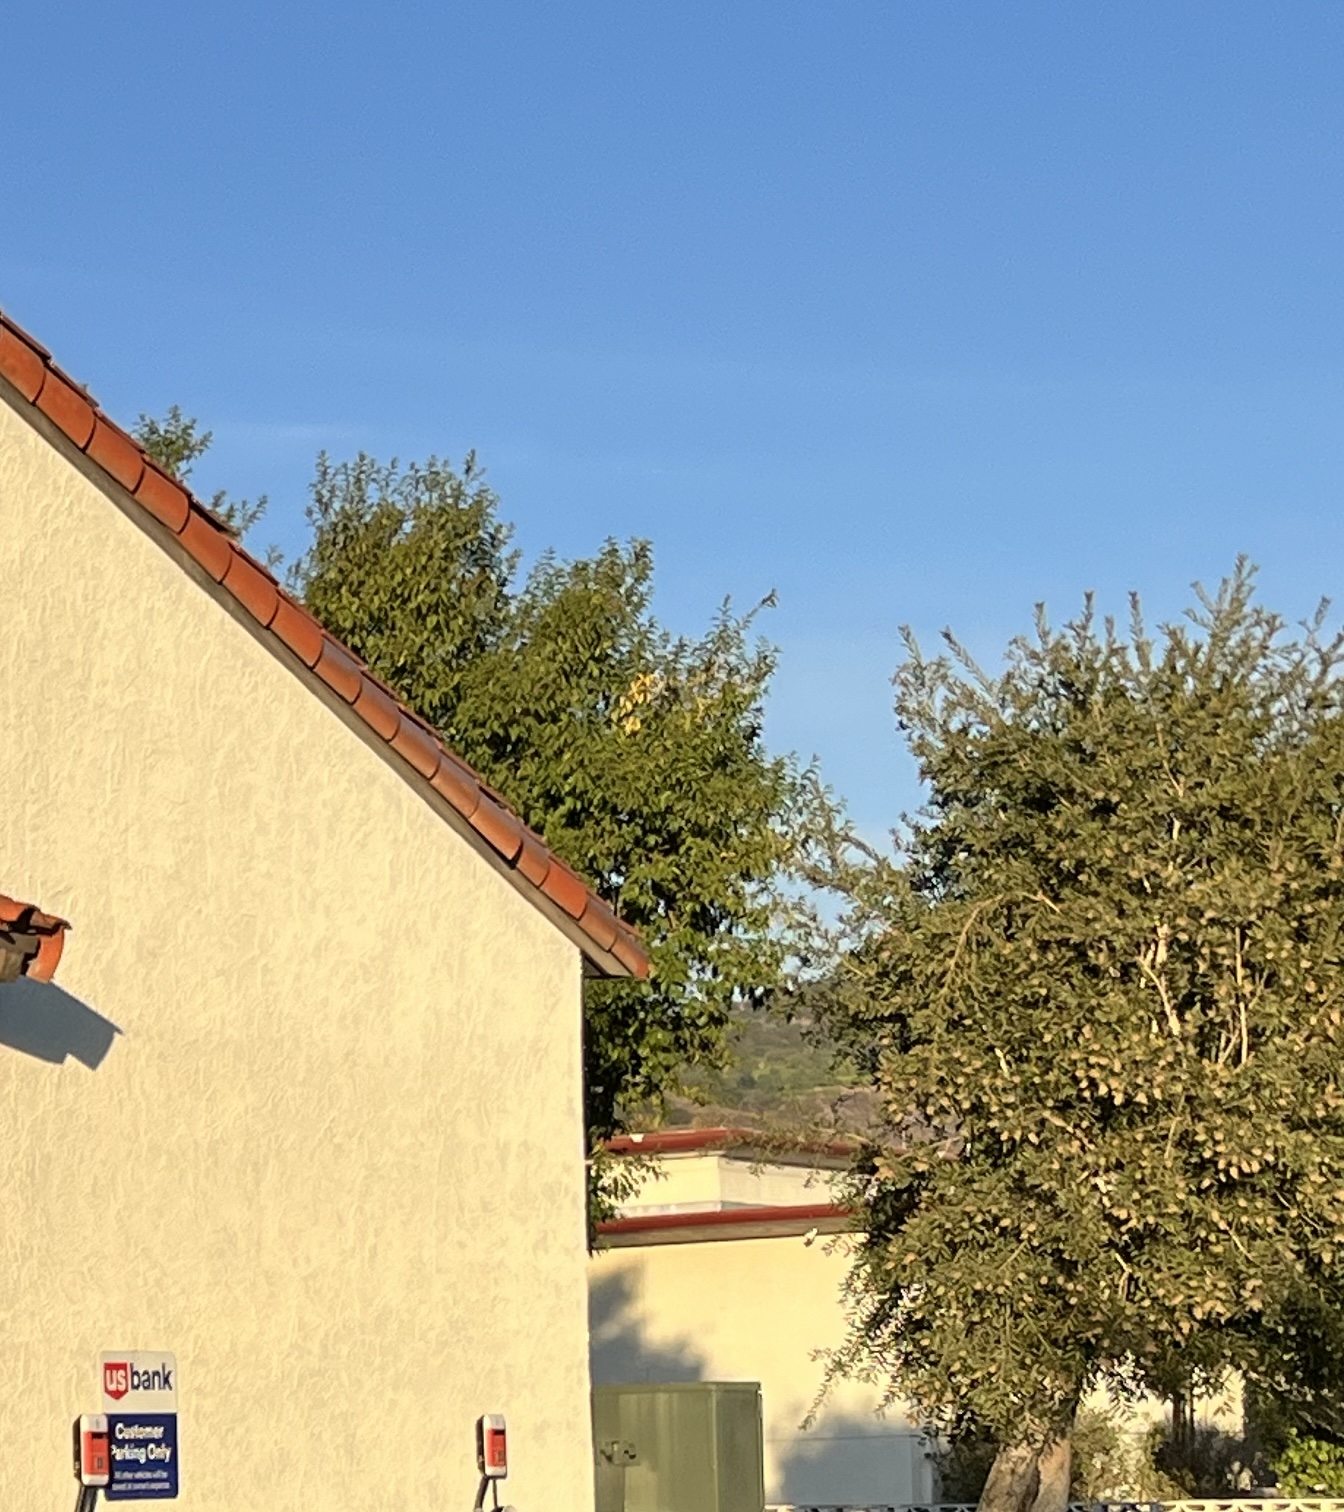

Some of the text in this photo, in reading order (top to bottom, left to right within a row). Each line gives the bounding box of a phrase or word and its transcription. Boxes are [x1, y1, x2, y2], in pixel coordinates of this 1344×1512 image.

[130, 1362, 173, 1392] bank
[115, 1422, 164, 1440] Customer
[147, 1442, 172, 1463] Only
